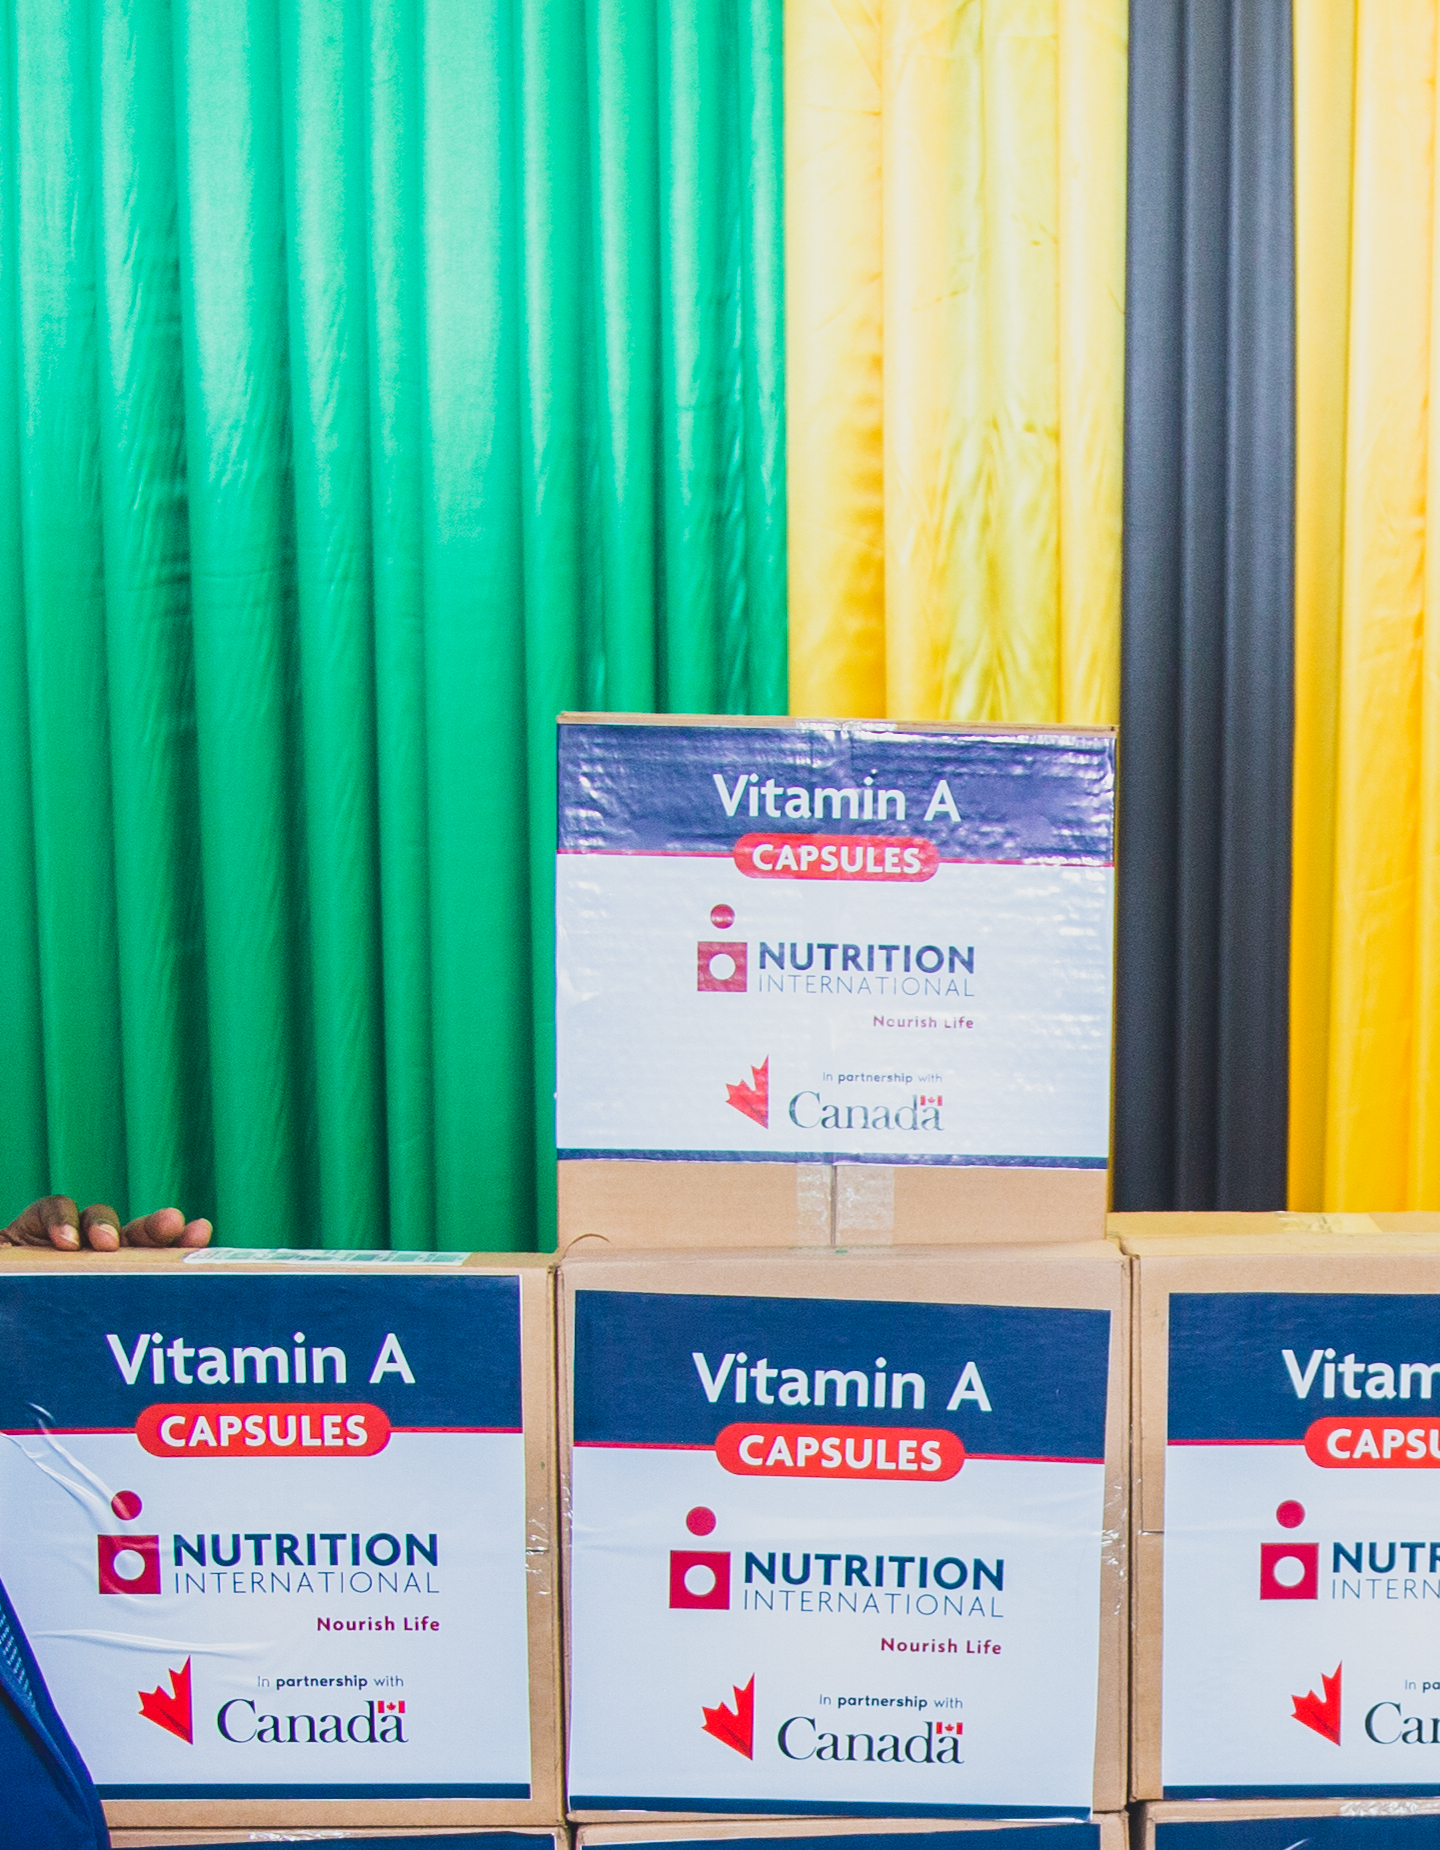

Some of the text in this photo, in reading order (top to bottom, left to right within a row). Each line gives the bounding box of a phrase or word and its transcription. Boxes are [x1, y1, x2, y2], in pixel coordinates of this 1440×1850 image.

[713, 773, 961, 823] Vitamin A
[753, 844, 924, 874] CAPSULES
[759, 942, 974, 974] NUTRITION
[760, 975, 973, 996] INTERNATIONAL
[874, 1016, 973, 1029] Nourish Life
[822, 1072, 943, 1084] In partnership with
[788, 1092, 944, 1130] Canada
[107, 1332, 415, 1384] Vitamin A
[692, 1352, 991, 1411] Vitamin A
[161, 1415, 367, 1447] CAPSULES
[739, 1435, 941, 1471] CAPSULES
[173, 1533, 437, 1566] NUTRITION
[175, 1572, 438, 1593] INTERNATIONAL
[744, 1552, 1004, 1591] NUTRITION
[745, 1590, 1002, 1617] INTERNATIONAL
[317, 1616, 439, 1631] Nourish Life
[881, 1638, 1001, 1654] Nourish Life
[258, 1675, 404, 1690] In partnership with
[1405, 1680, 1417, 1690] In
[819, 1694, 963, 1711] In partnership with
[217, 1699, 408, 1743] Canada
[777, 1717, 964, 1764] Canada
